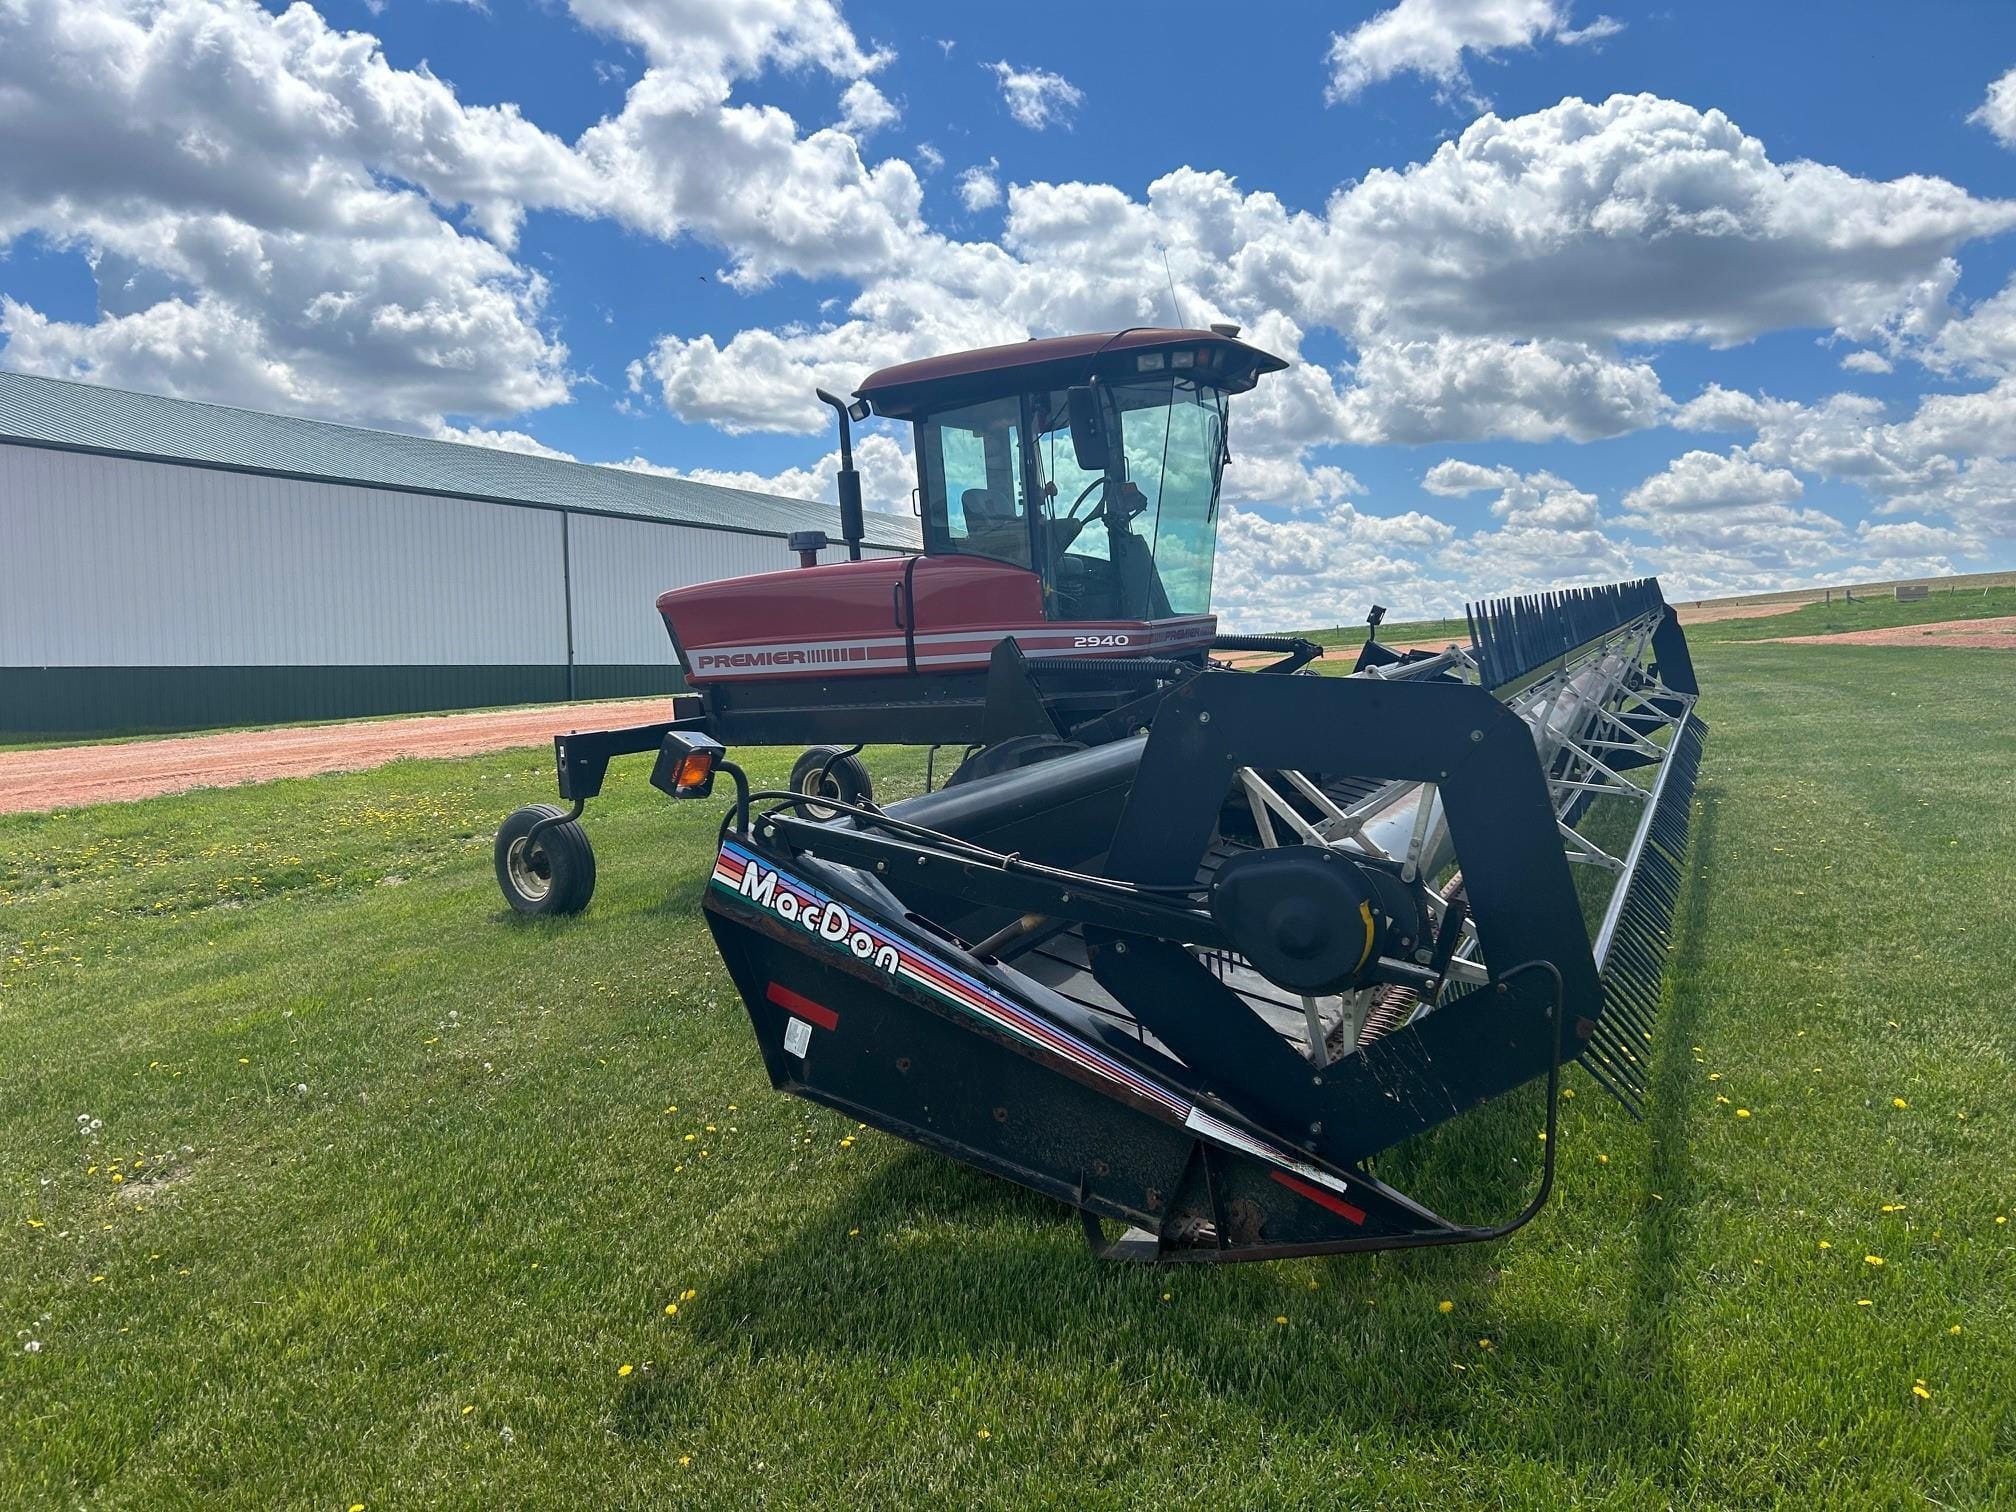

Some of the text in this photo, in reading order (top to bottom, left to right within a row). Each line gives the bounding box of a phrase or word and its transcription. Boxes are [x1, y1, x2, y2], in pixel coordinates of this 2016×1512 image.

[1074, 635, 1129, 648] 2940
[698, 651, 805, 669] PREMIER
[739, 860, 900, 976] MacDon
